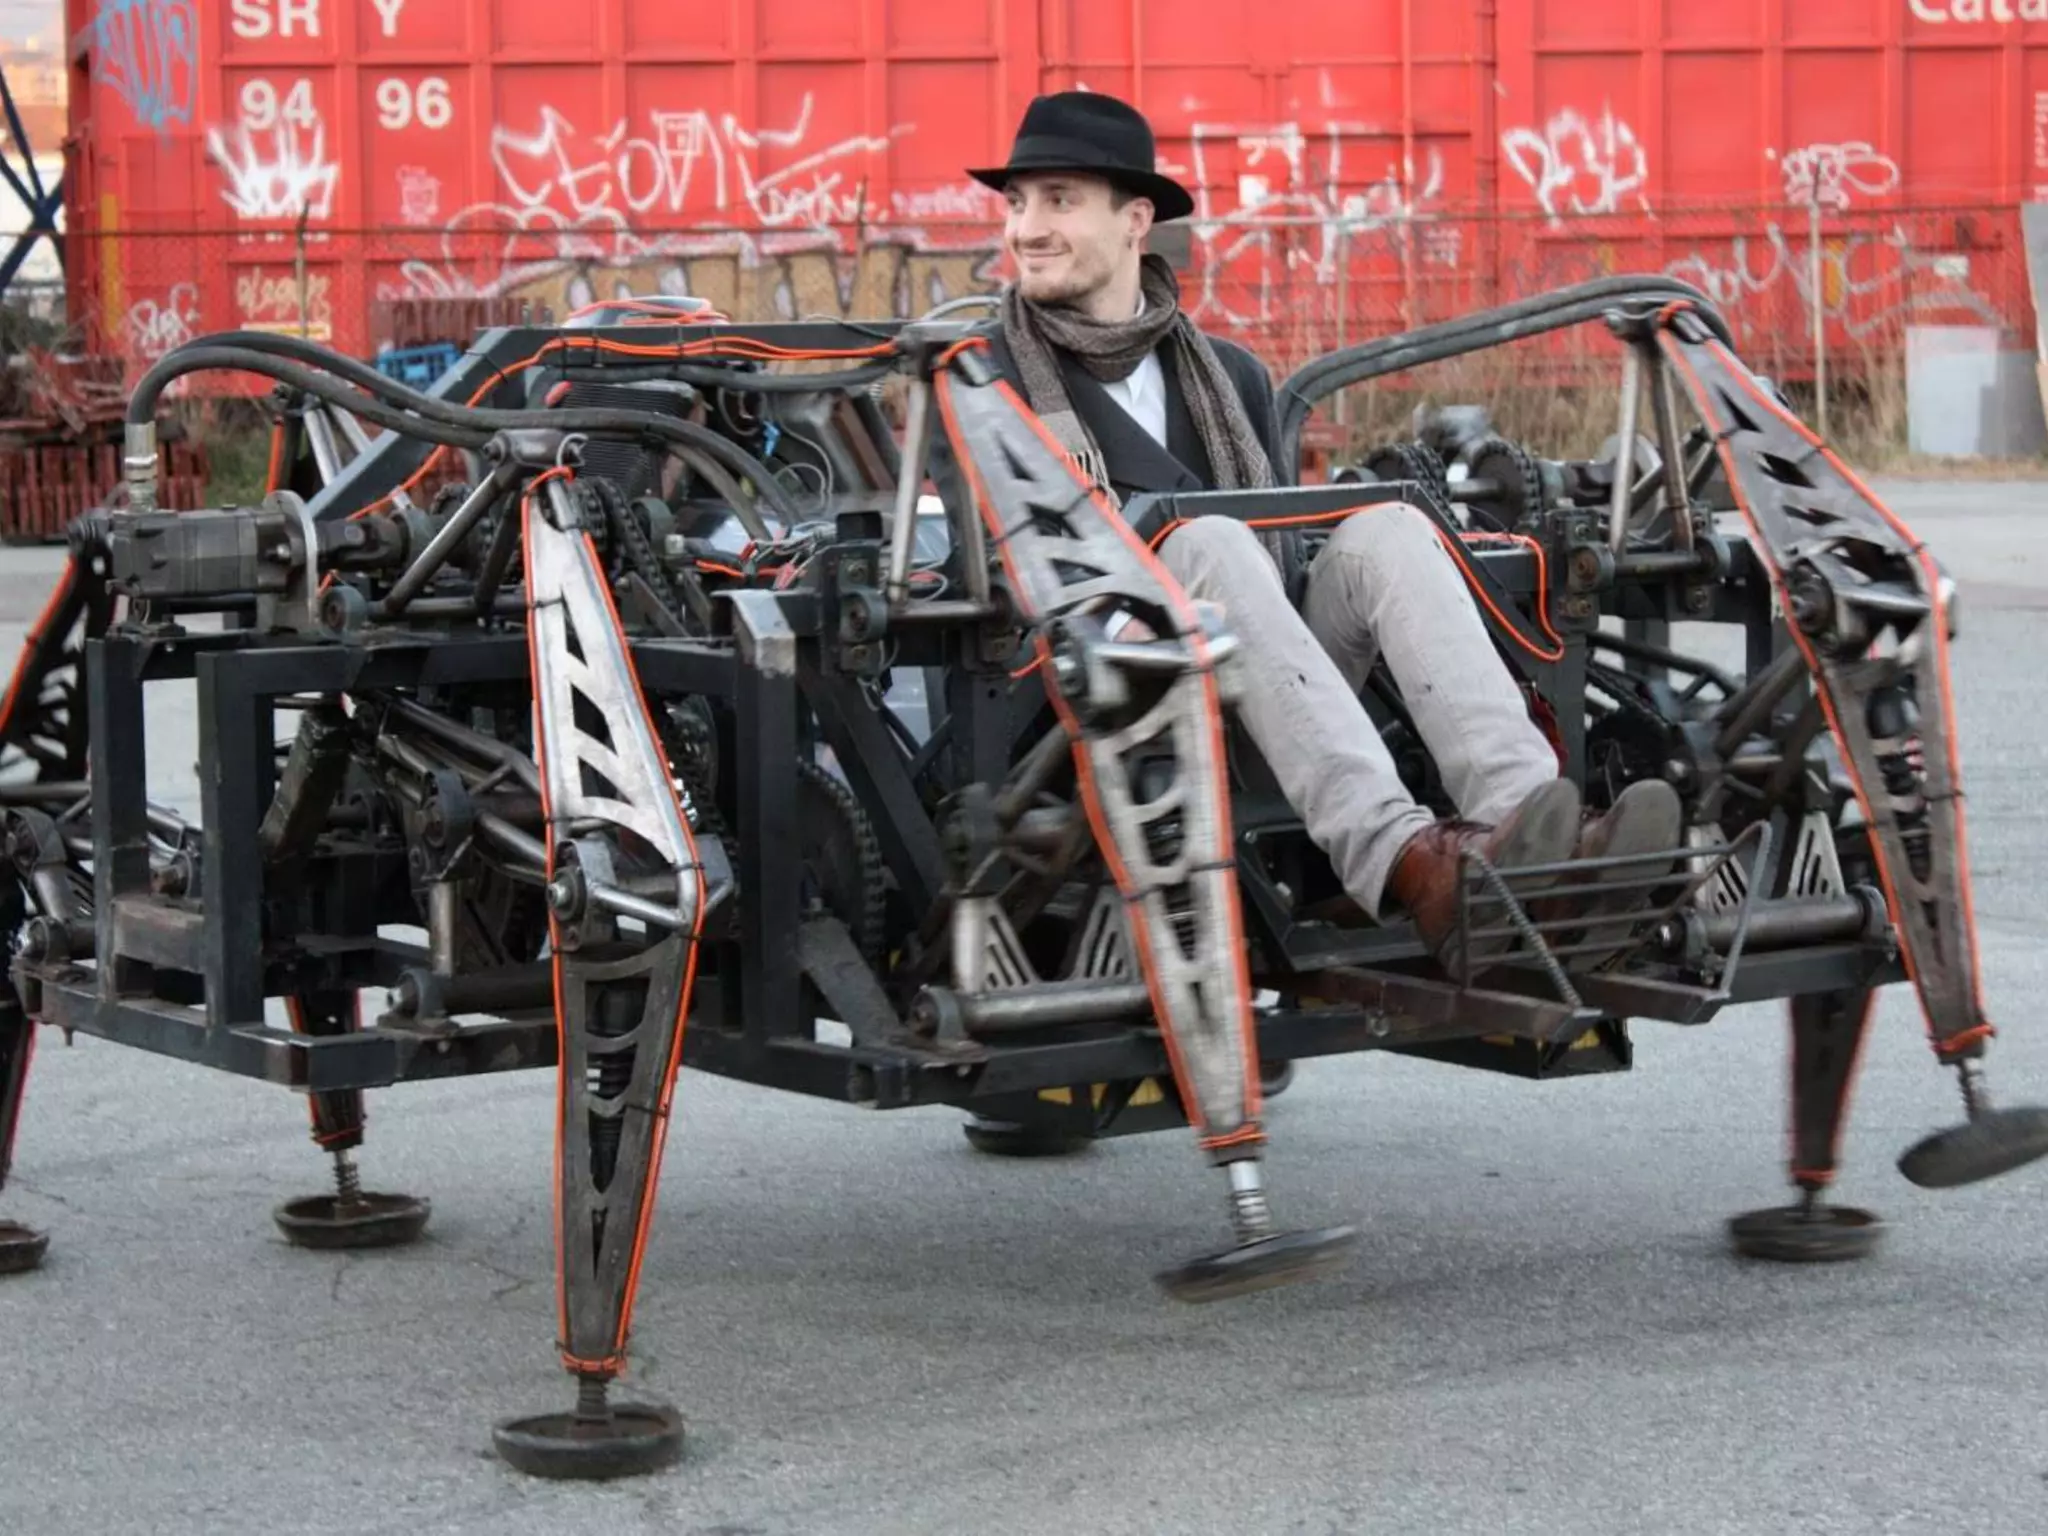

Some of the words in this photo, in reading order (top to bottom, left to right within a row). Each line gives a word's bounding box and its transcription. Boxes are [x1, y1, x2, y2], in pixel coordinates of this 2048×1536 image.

[231, 0, 321, 38] SR
[373, 0, 404, 38] Y
[242, 77, 318, 131] 94
[376, 76, 453, 130] 96
